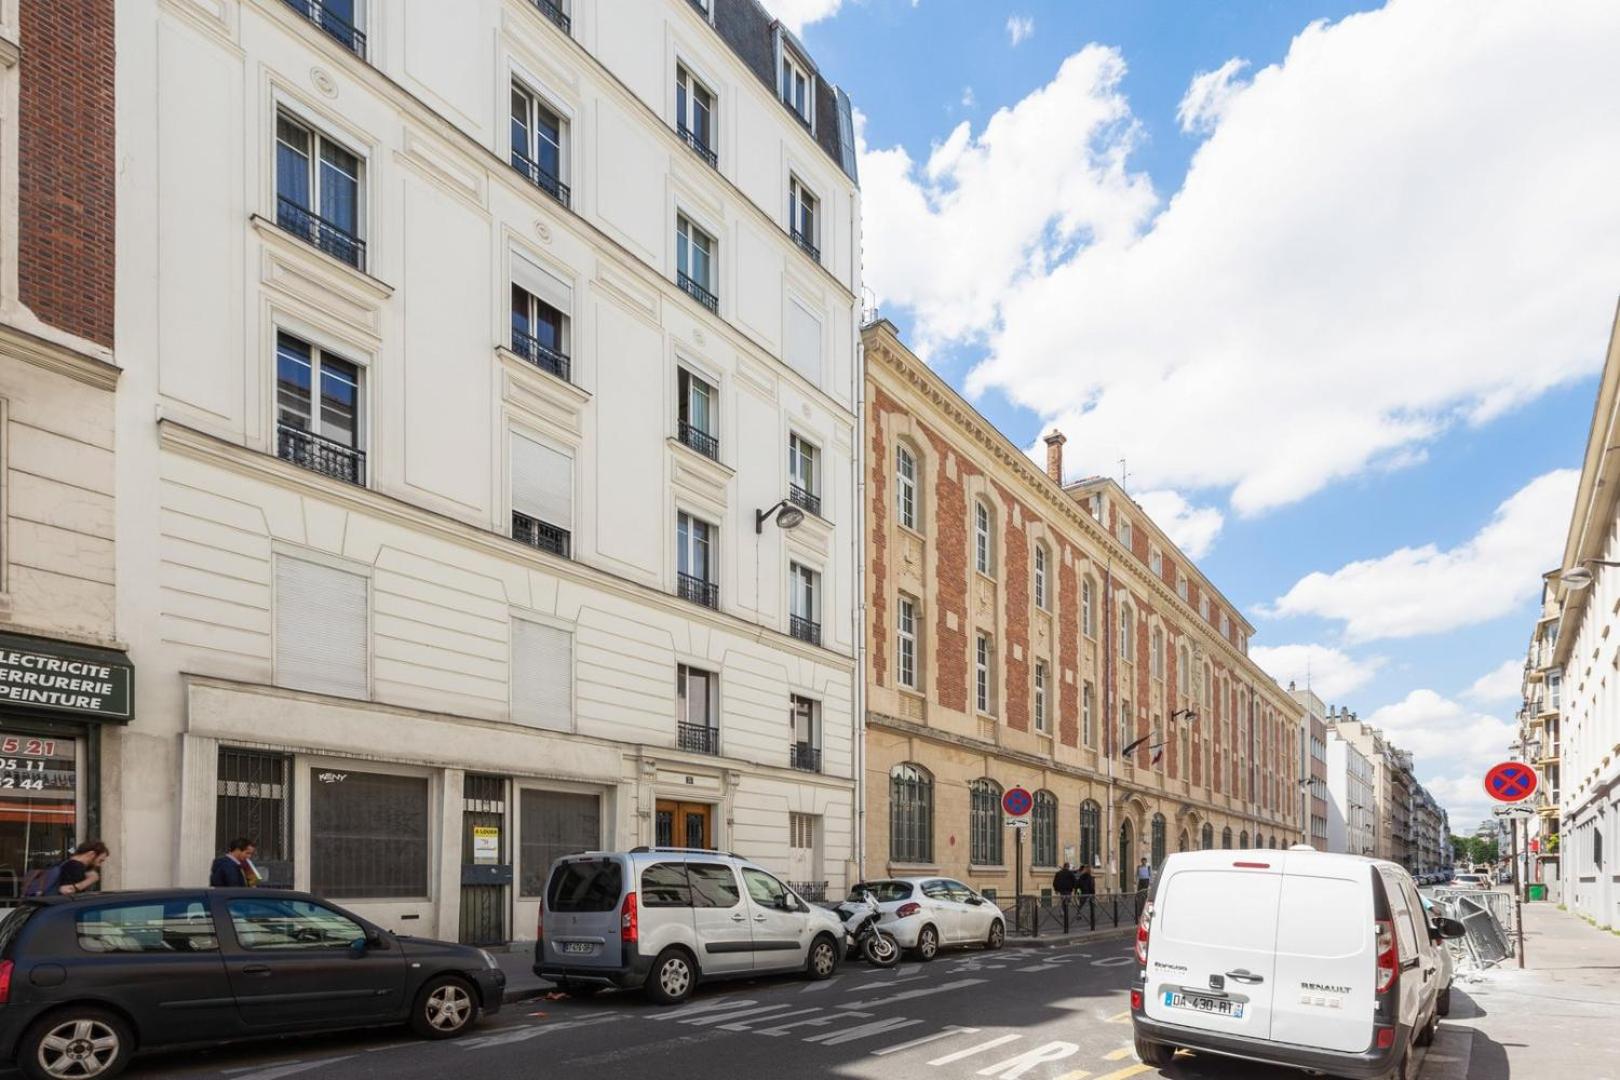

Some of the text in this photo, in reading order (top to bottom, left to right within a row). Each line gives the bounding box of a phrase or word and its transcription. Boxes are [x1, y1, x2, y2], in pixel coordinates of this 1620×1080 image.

[0, 685, 102, 709] PEINTURE
[24, 739, 55, 756] 21
[26, 760, 45, 772] 11
[19, 779, 44, 791] 44
[1300, 982, 1352, 994] RENAULT
